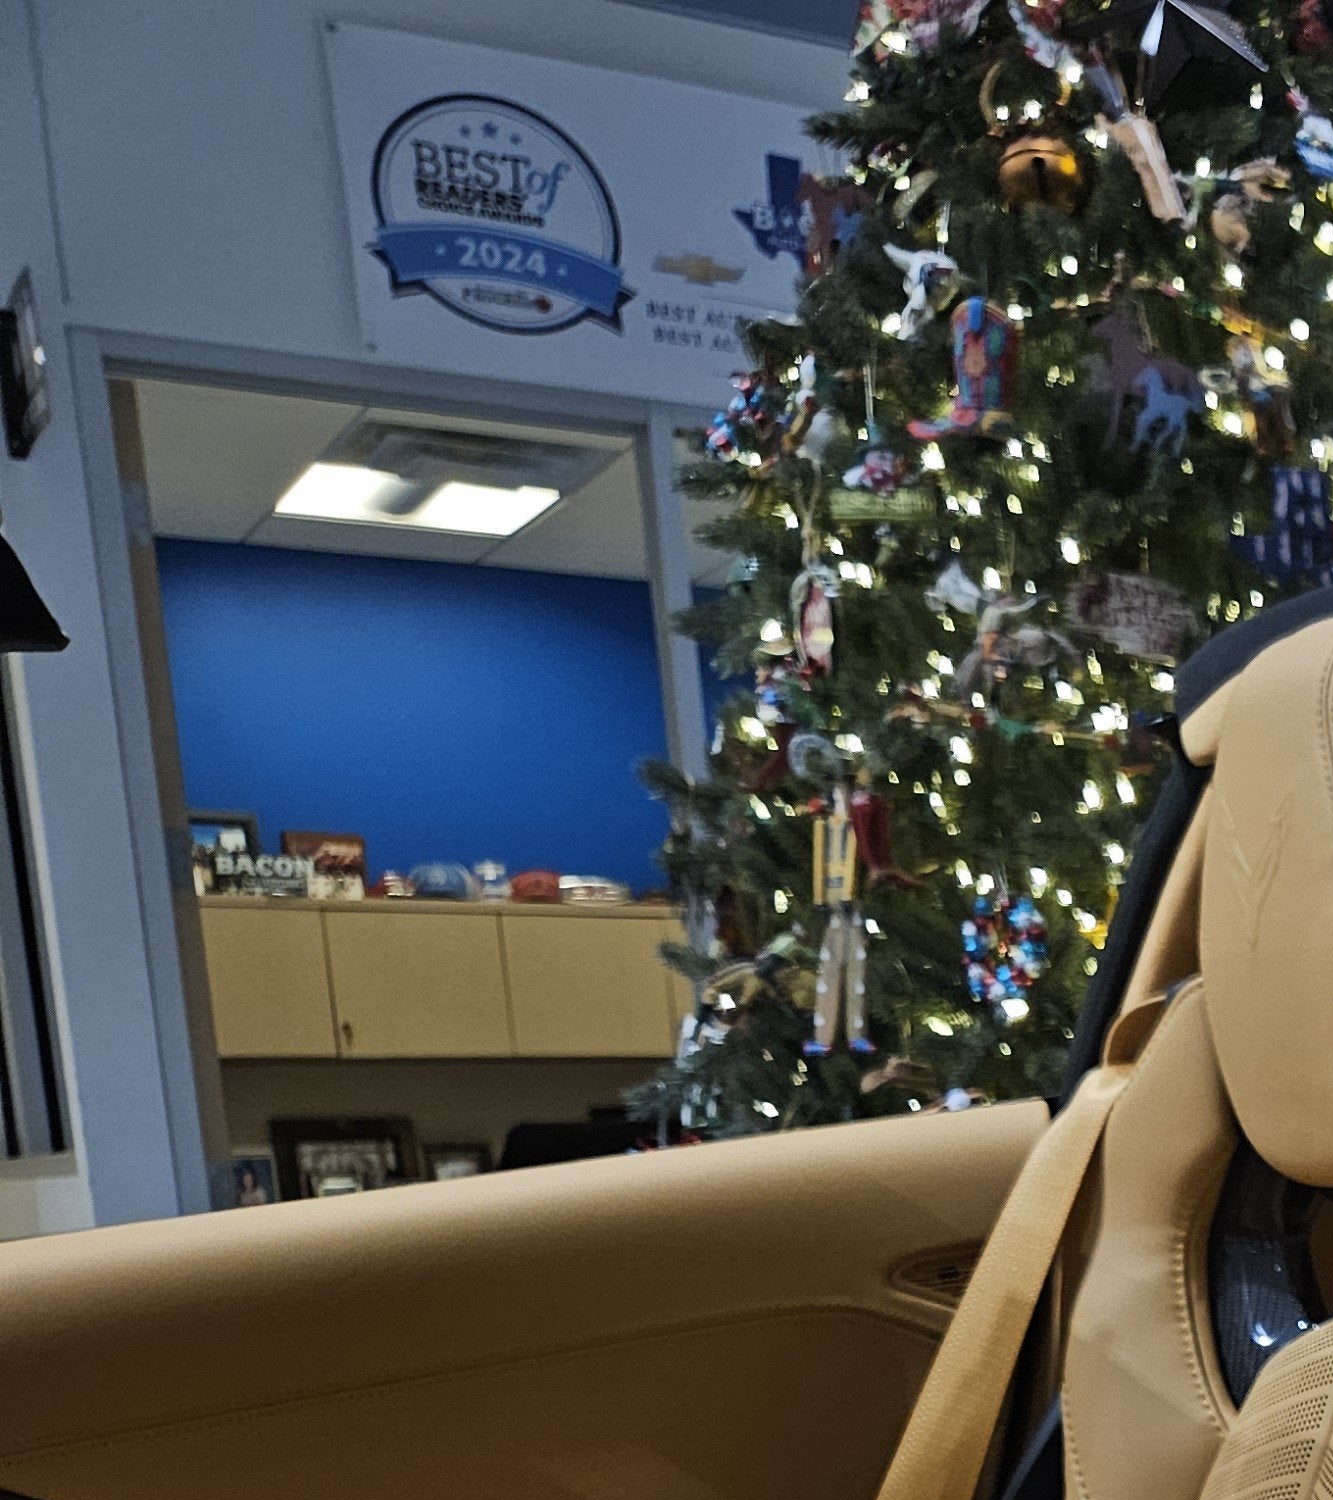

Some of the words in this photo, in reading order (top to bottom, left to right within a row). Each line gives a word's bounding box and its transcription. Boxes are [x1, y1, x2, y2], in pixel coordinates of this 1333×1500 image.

[411, 138, 531, 194] BEST
[526, 160, 571, 215] of
[455, 237, 545, 278] 2024
[215, 854, 315, 877] BACON
